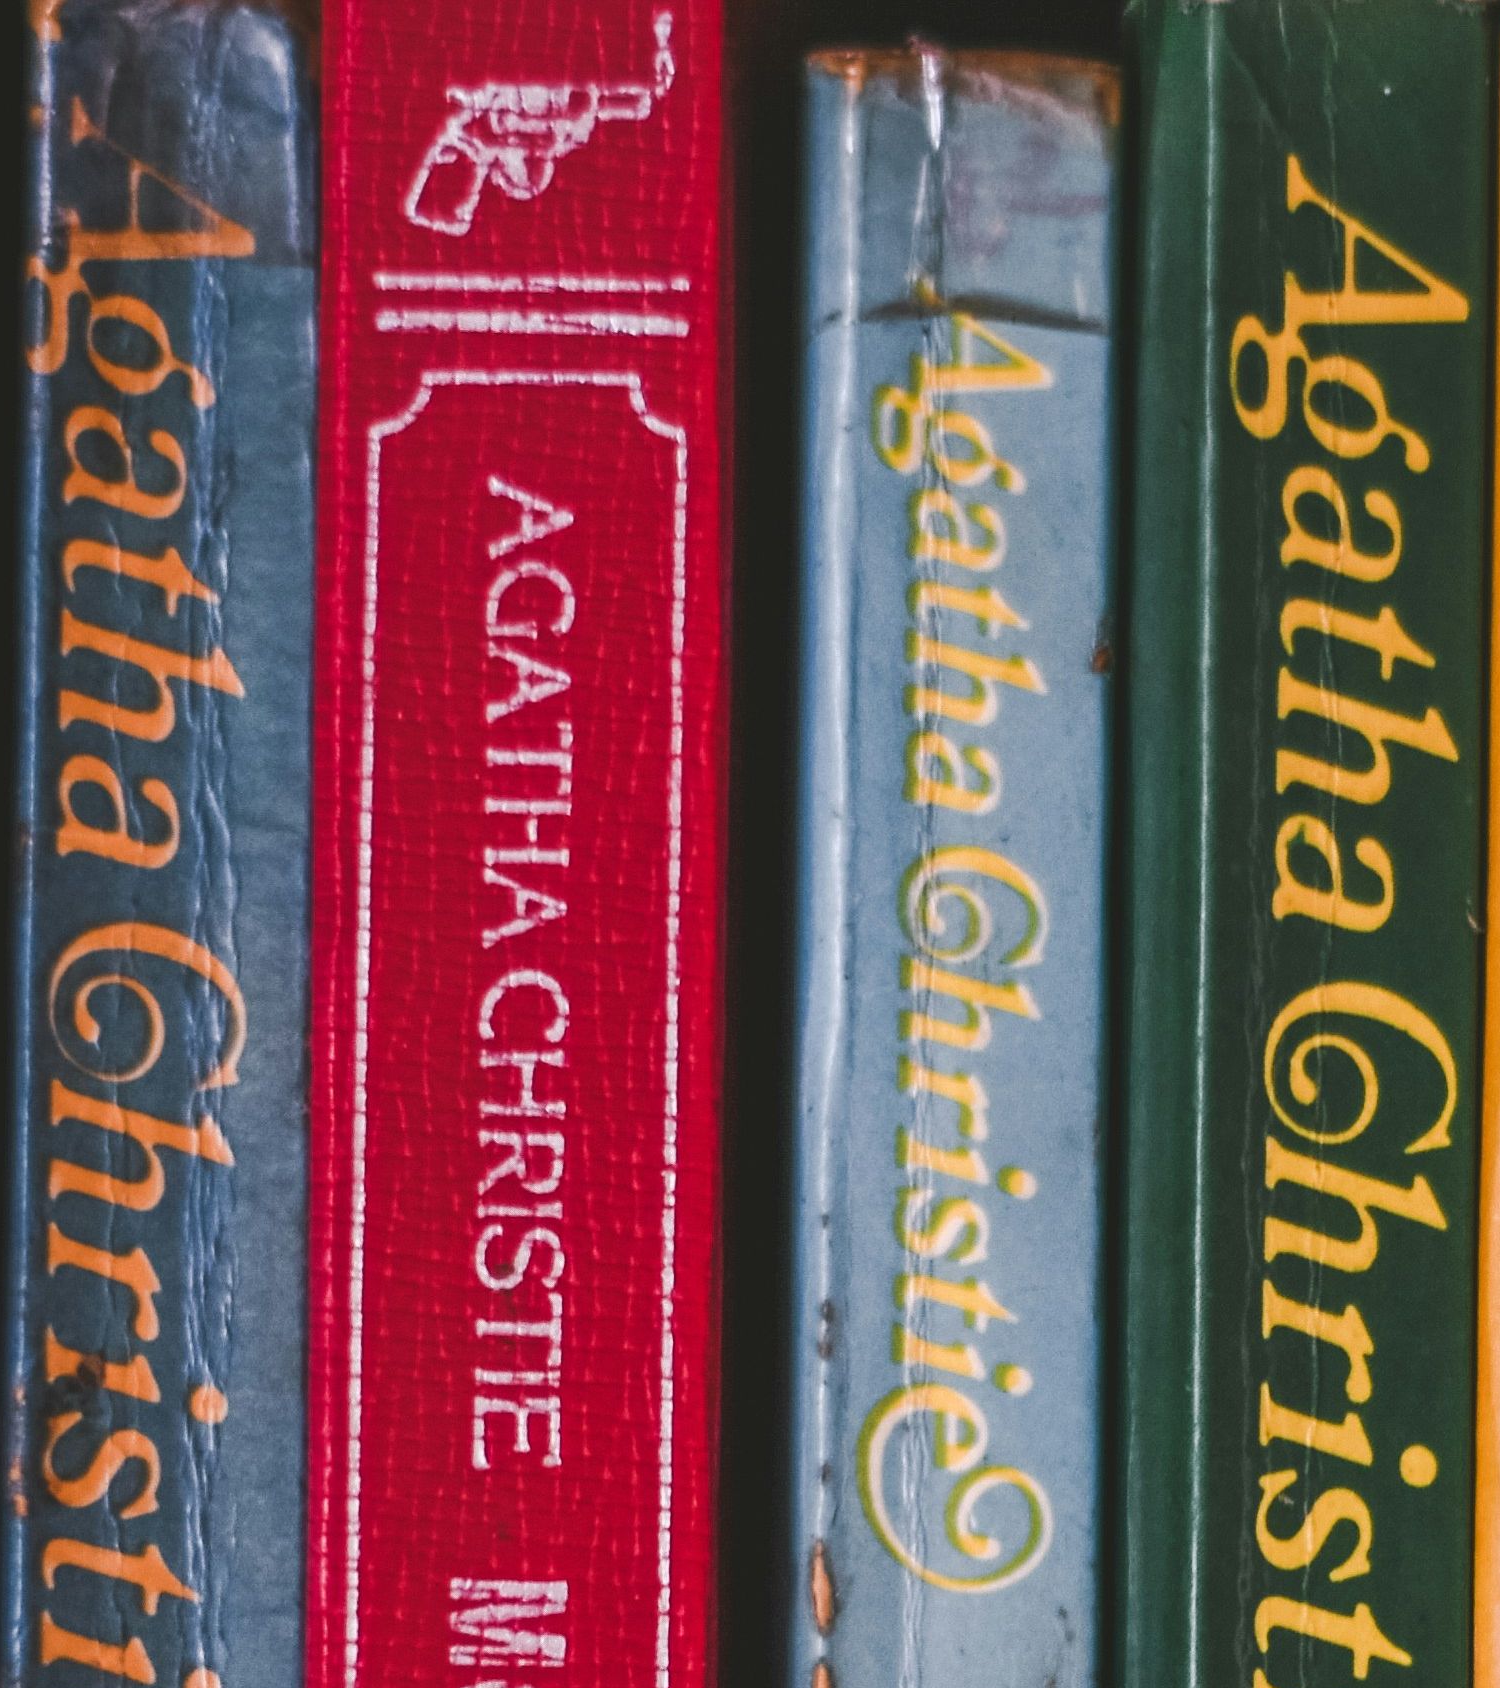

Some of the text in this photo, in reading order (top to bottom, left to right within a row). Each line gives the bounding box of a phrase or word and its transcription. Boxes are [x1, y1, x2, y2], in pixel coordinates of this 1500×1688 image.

[27, 100, 257, 870] Agatha
[481, 475, 574, 950] AGATHA
[872, 282, 1056, 814] Agatha
[1230, 153, 1473, 934] Agatha
[472, 970, 569, 1472] CHRISTIE
[857, 843, 1054, 1594] Christie
